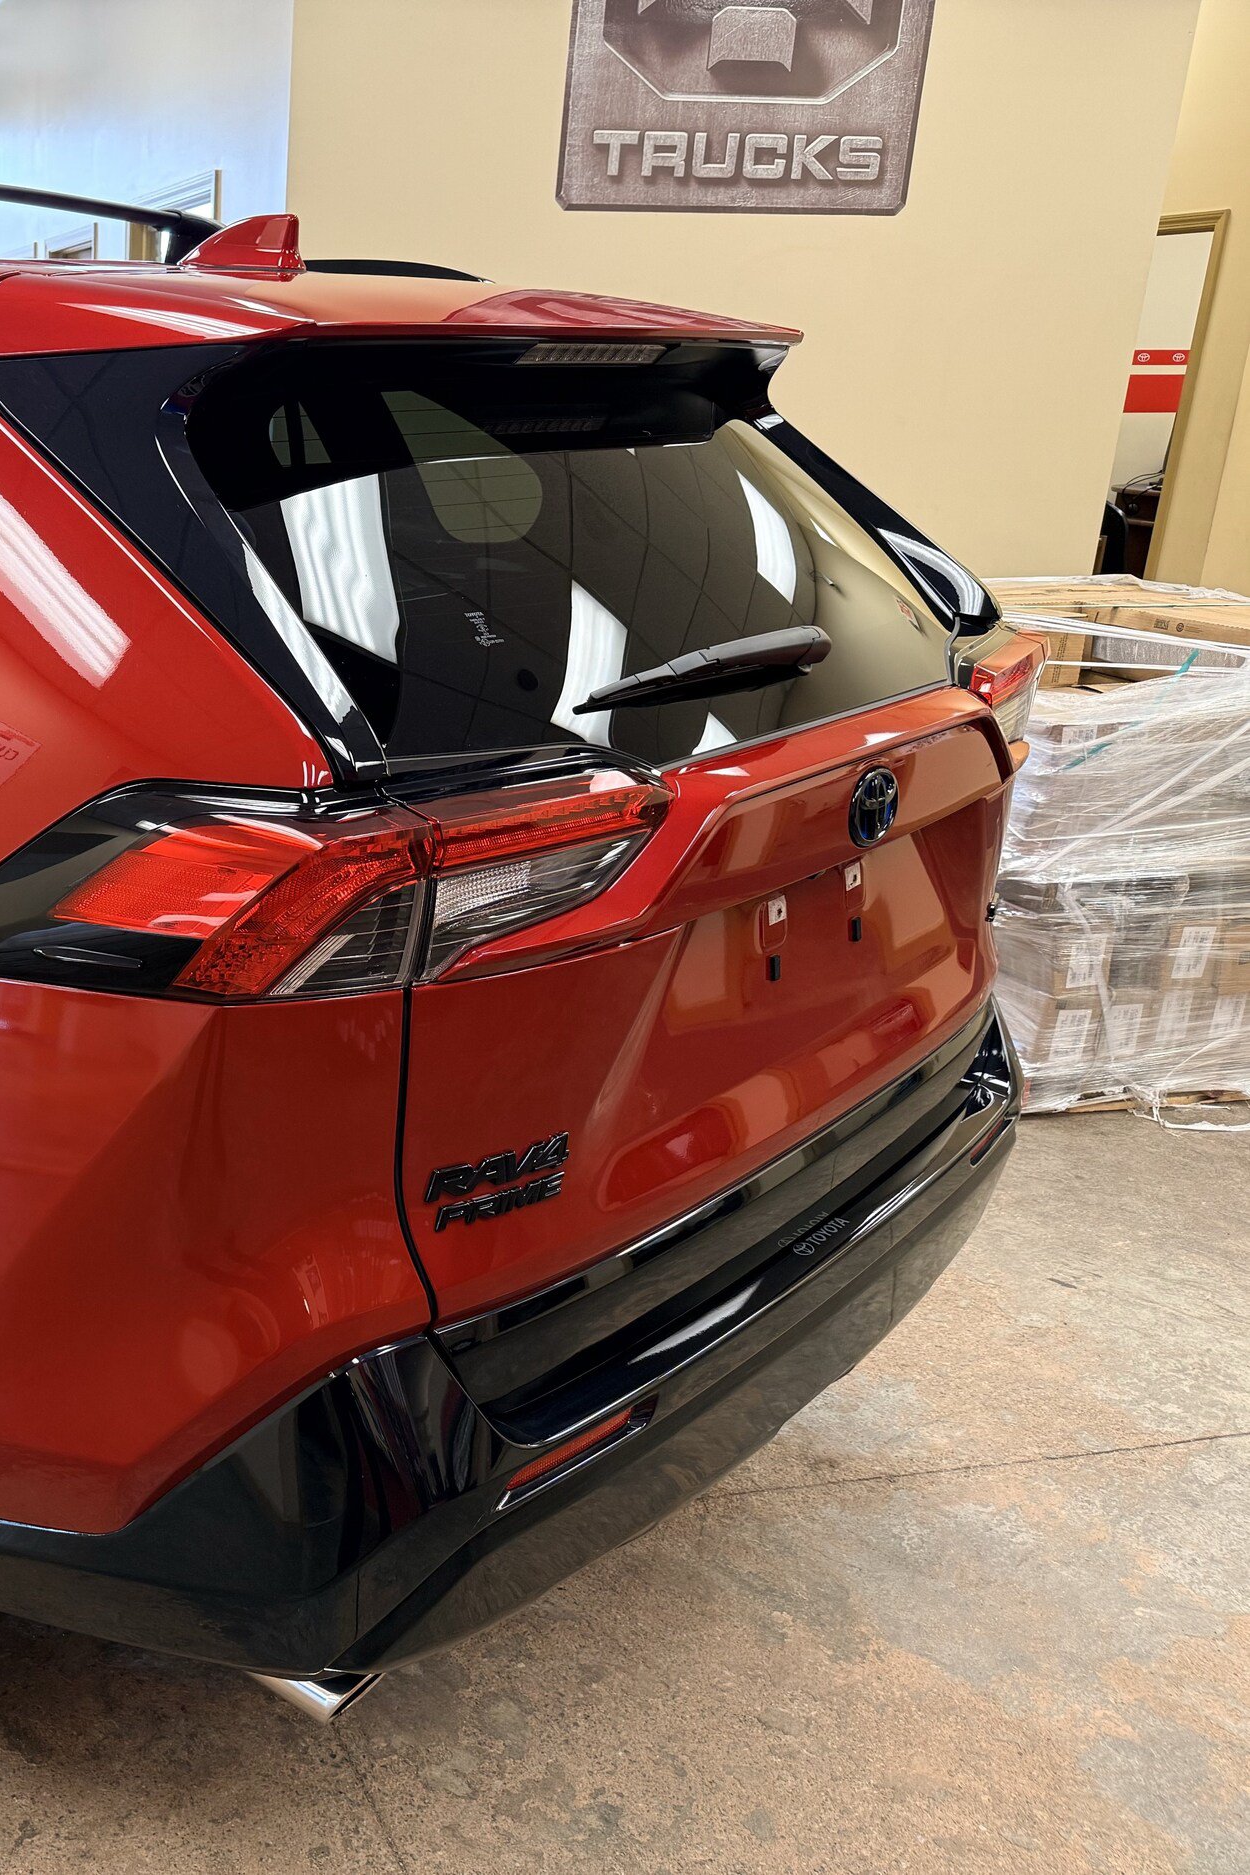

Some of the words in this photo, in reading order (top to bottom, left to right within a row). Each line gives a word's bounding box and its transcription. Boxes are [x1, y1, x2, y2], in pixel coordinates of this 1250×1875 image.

[592, 129, 884, 182] TRUCKS
[424, 1130, 570, 1203] RAV4
[434, 1171, 565, 1232] PRIME
[807, 1216, 851, 1246] TOYOTA
